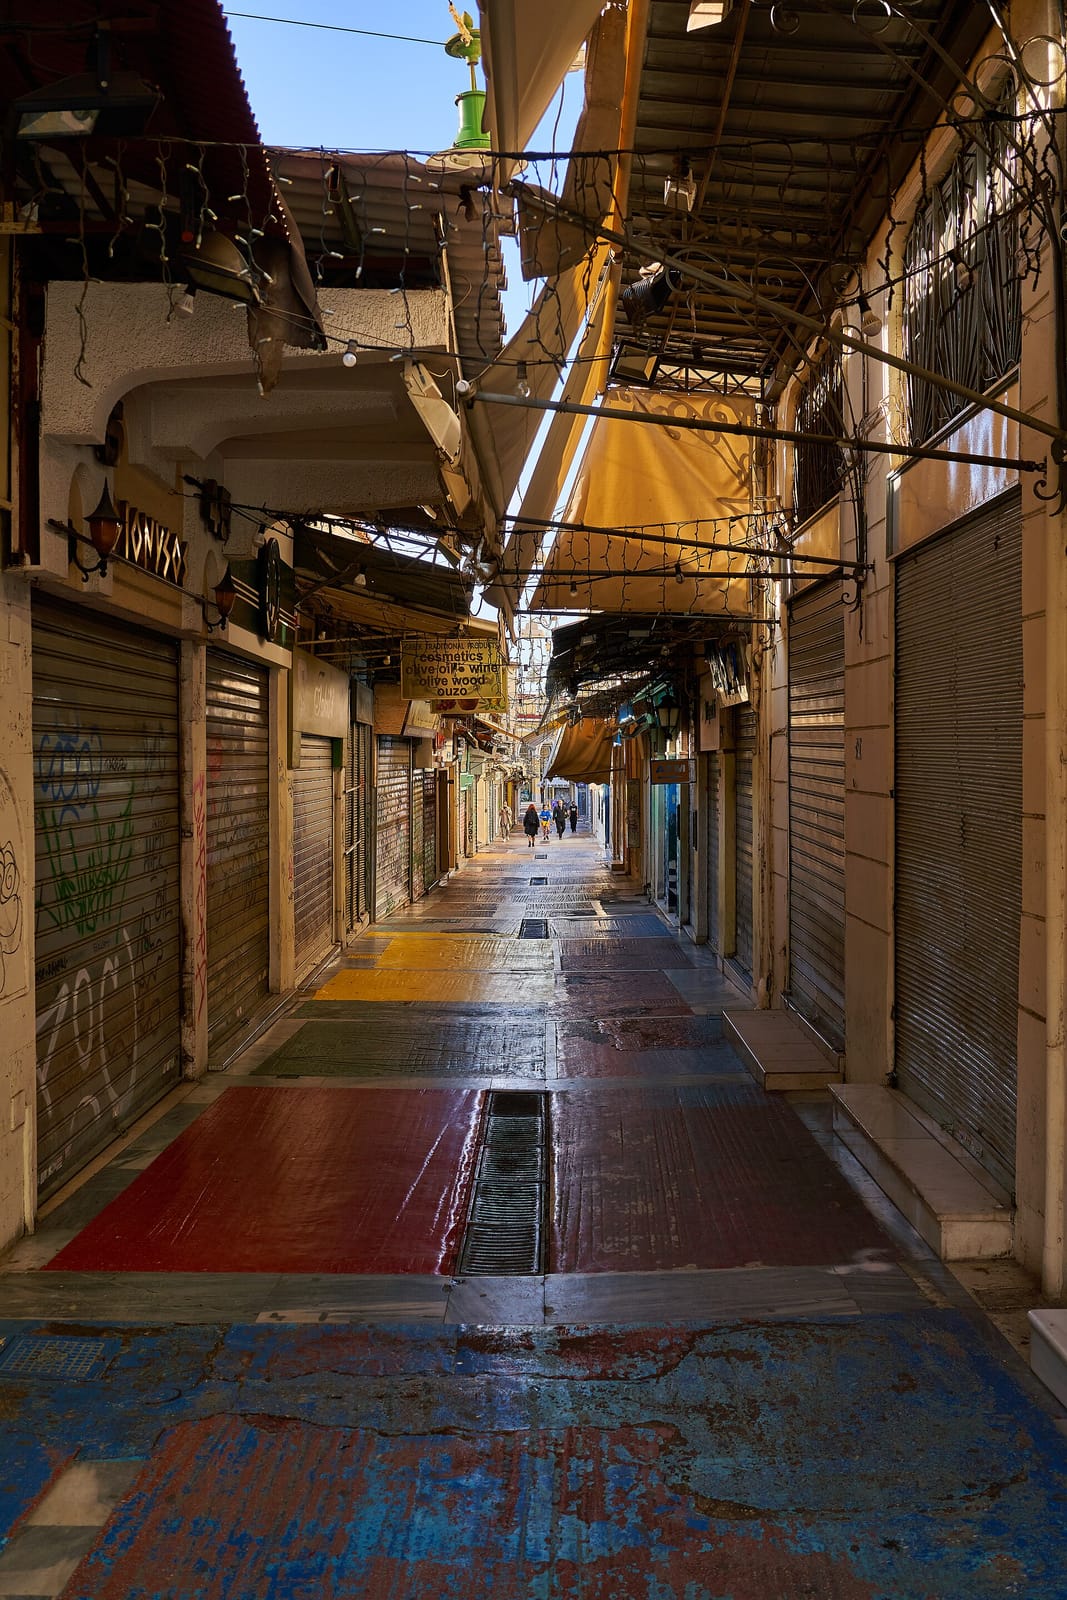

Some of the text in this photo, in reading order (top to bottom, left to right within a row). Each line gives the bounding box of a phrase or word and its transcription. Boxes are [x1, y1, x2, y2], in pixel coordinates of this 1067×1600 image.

[420, 651, 484, 663] cosmetics
[406, 663, 436, 675] olive
[469, 661, 498, 674] wine
[419, 674, 486, 686] olive wood
[437, 686, 468, 697] ouzo
